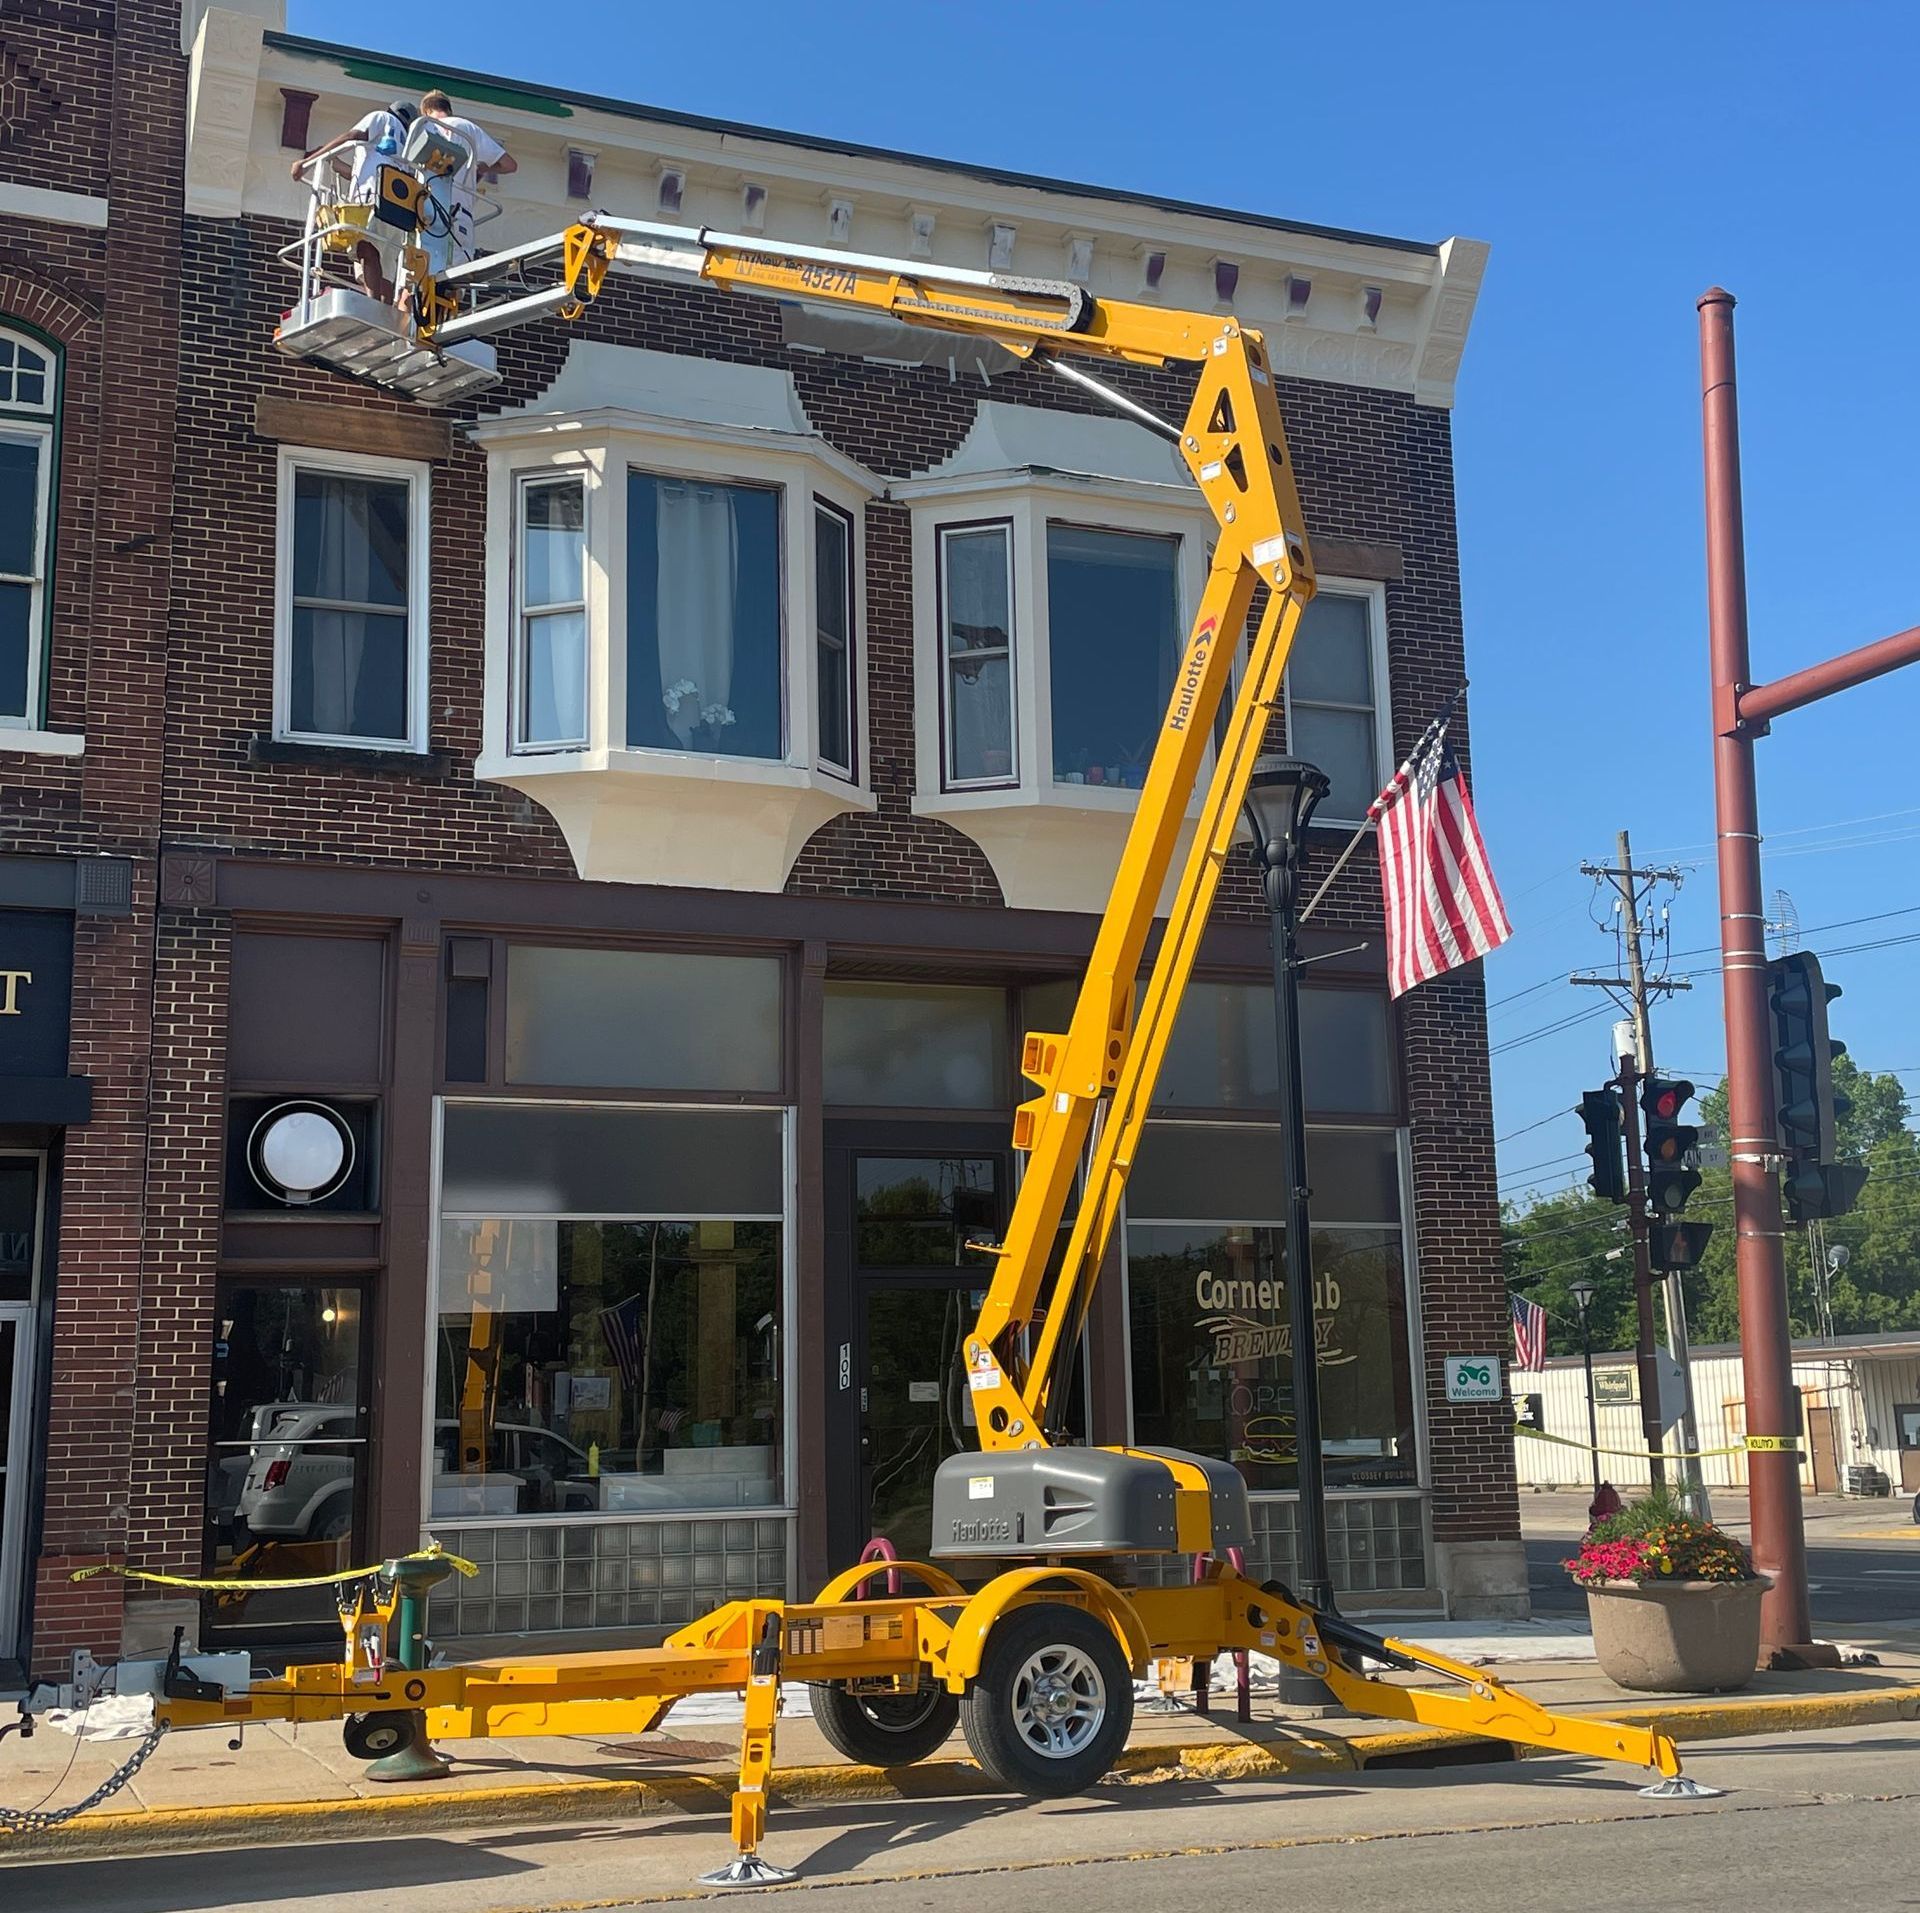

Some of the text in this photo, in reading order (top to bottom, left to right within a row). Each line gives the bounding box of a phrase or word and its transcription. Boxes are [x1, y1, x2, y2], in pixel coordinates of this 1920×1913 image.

[800, 264, 857, 295] 4527A
[1170, 650, 1206, 730] Haulotte
[1196, 1270, 1342, 1310] Corner ub
[841, 1345, 849, 1387] 100
[1231, 1386, 1296, 1416] OPE
[1452, 1387, 1497, 1397] Welcome
[952, 1518, 1010, 1543] Haulotte
